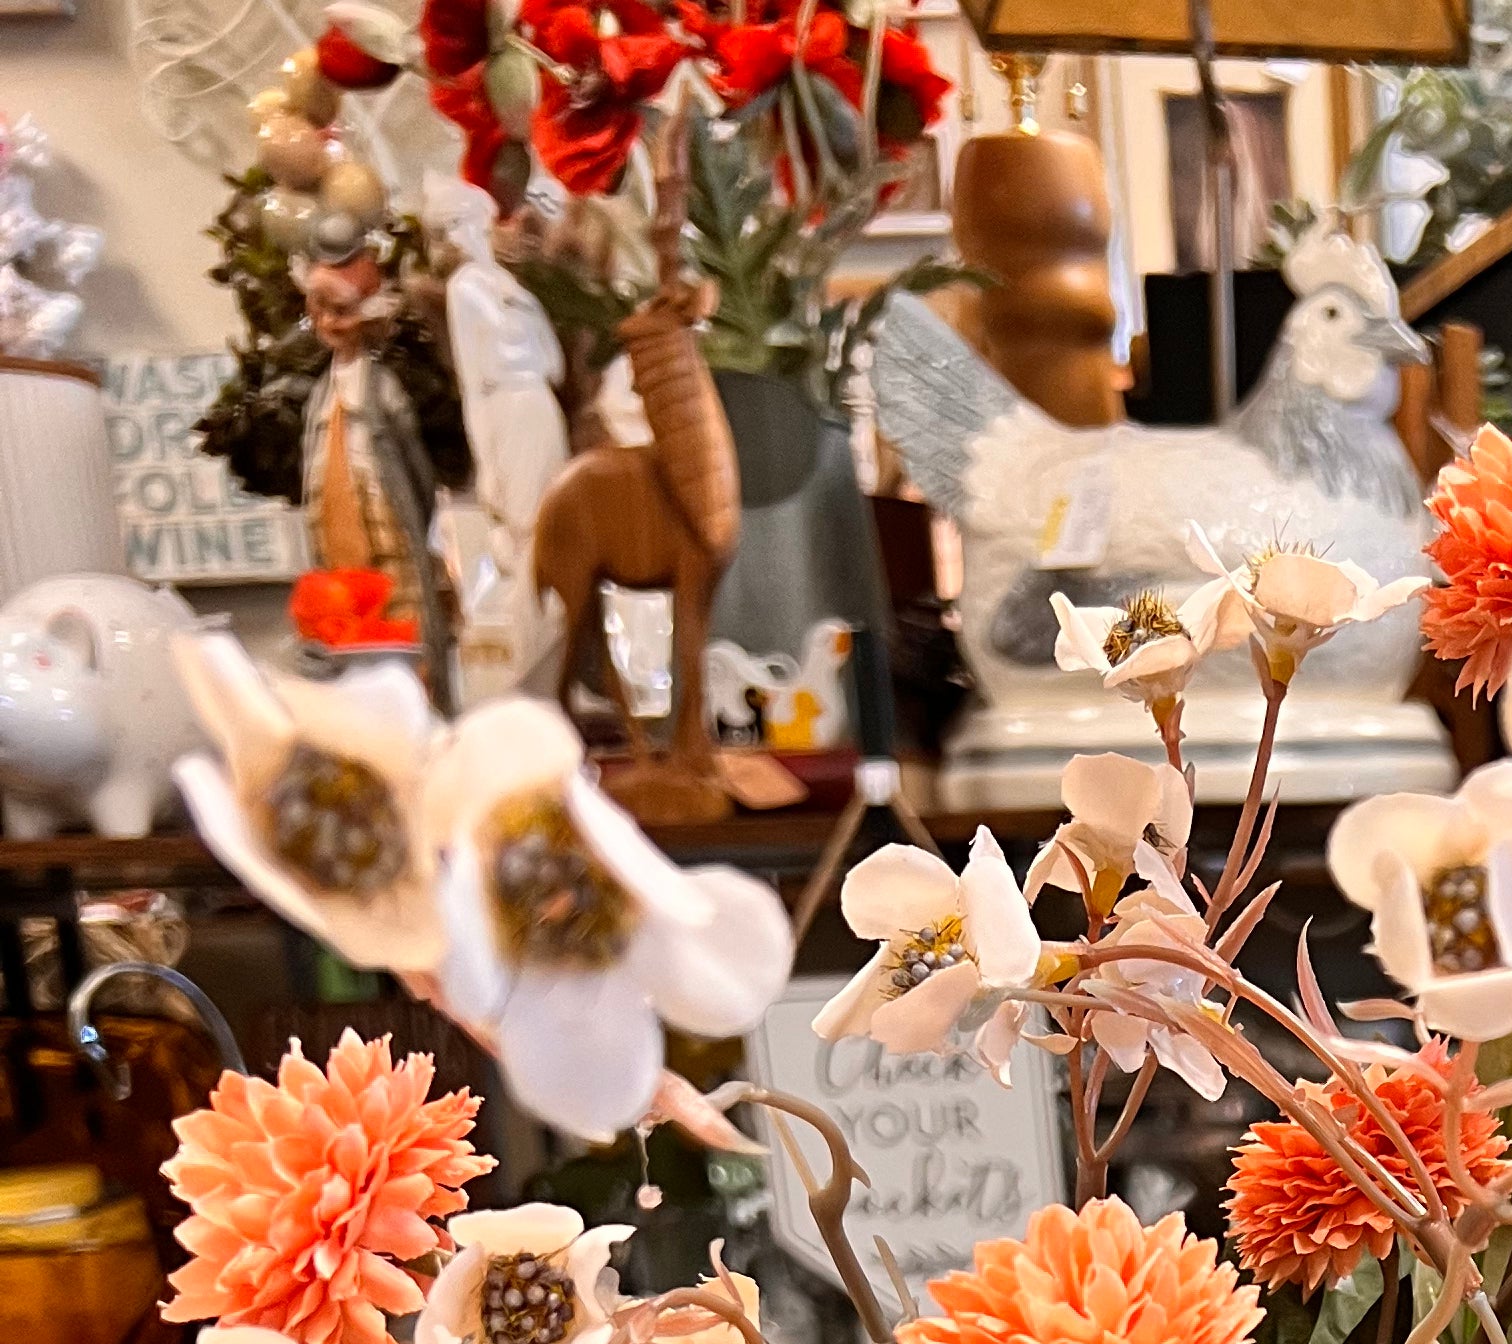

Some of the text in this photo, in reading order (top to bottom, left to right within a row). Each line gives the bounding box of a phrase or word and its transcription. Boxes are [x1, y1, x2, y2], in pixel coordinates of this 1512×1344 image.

[104, 411, 198, 460] DR
[126, 518, 275, 568] WINE
[836, 1098, 984, 1146] YOUR
